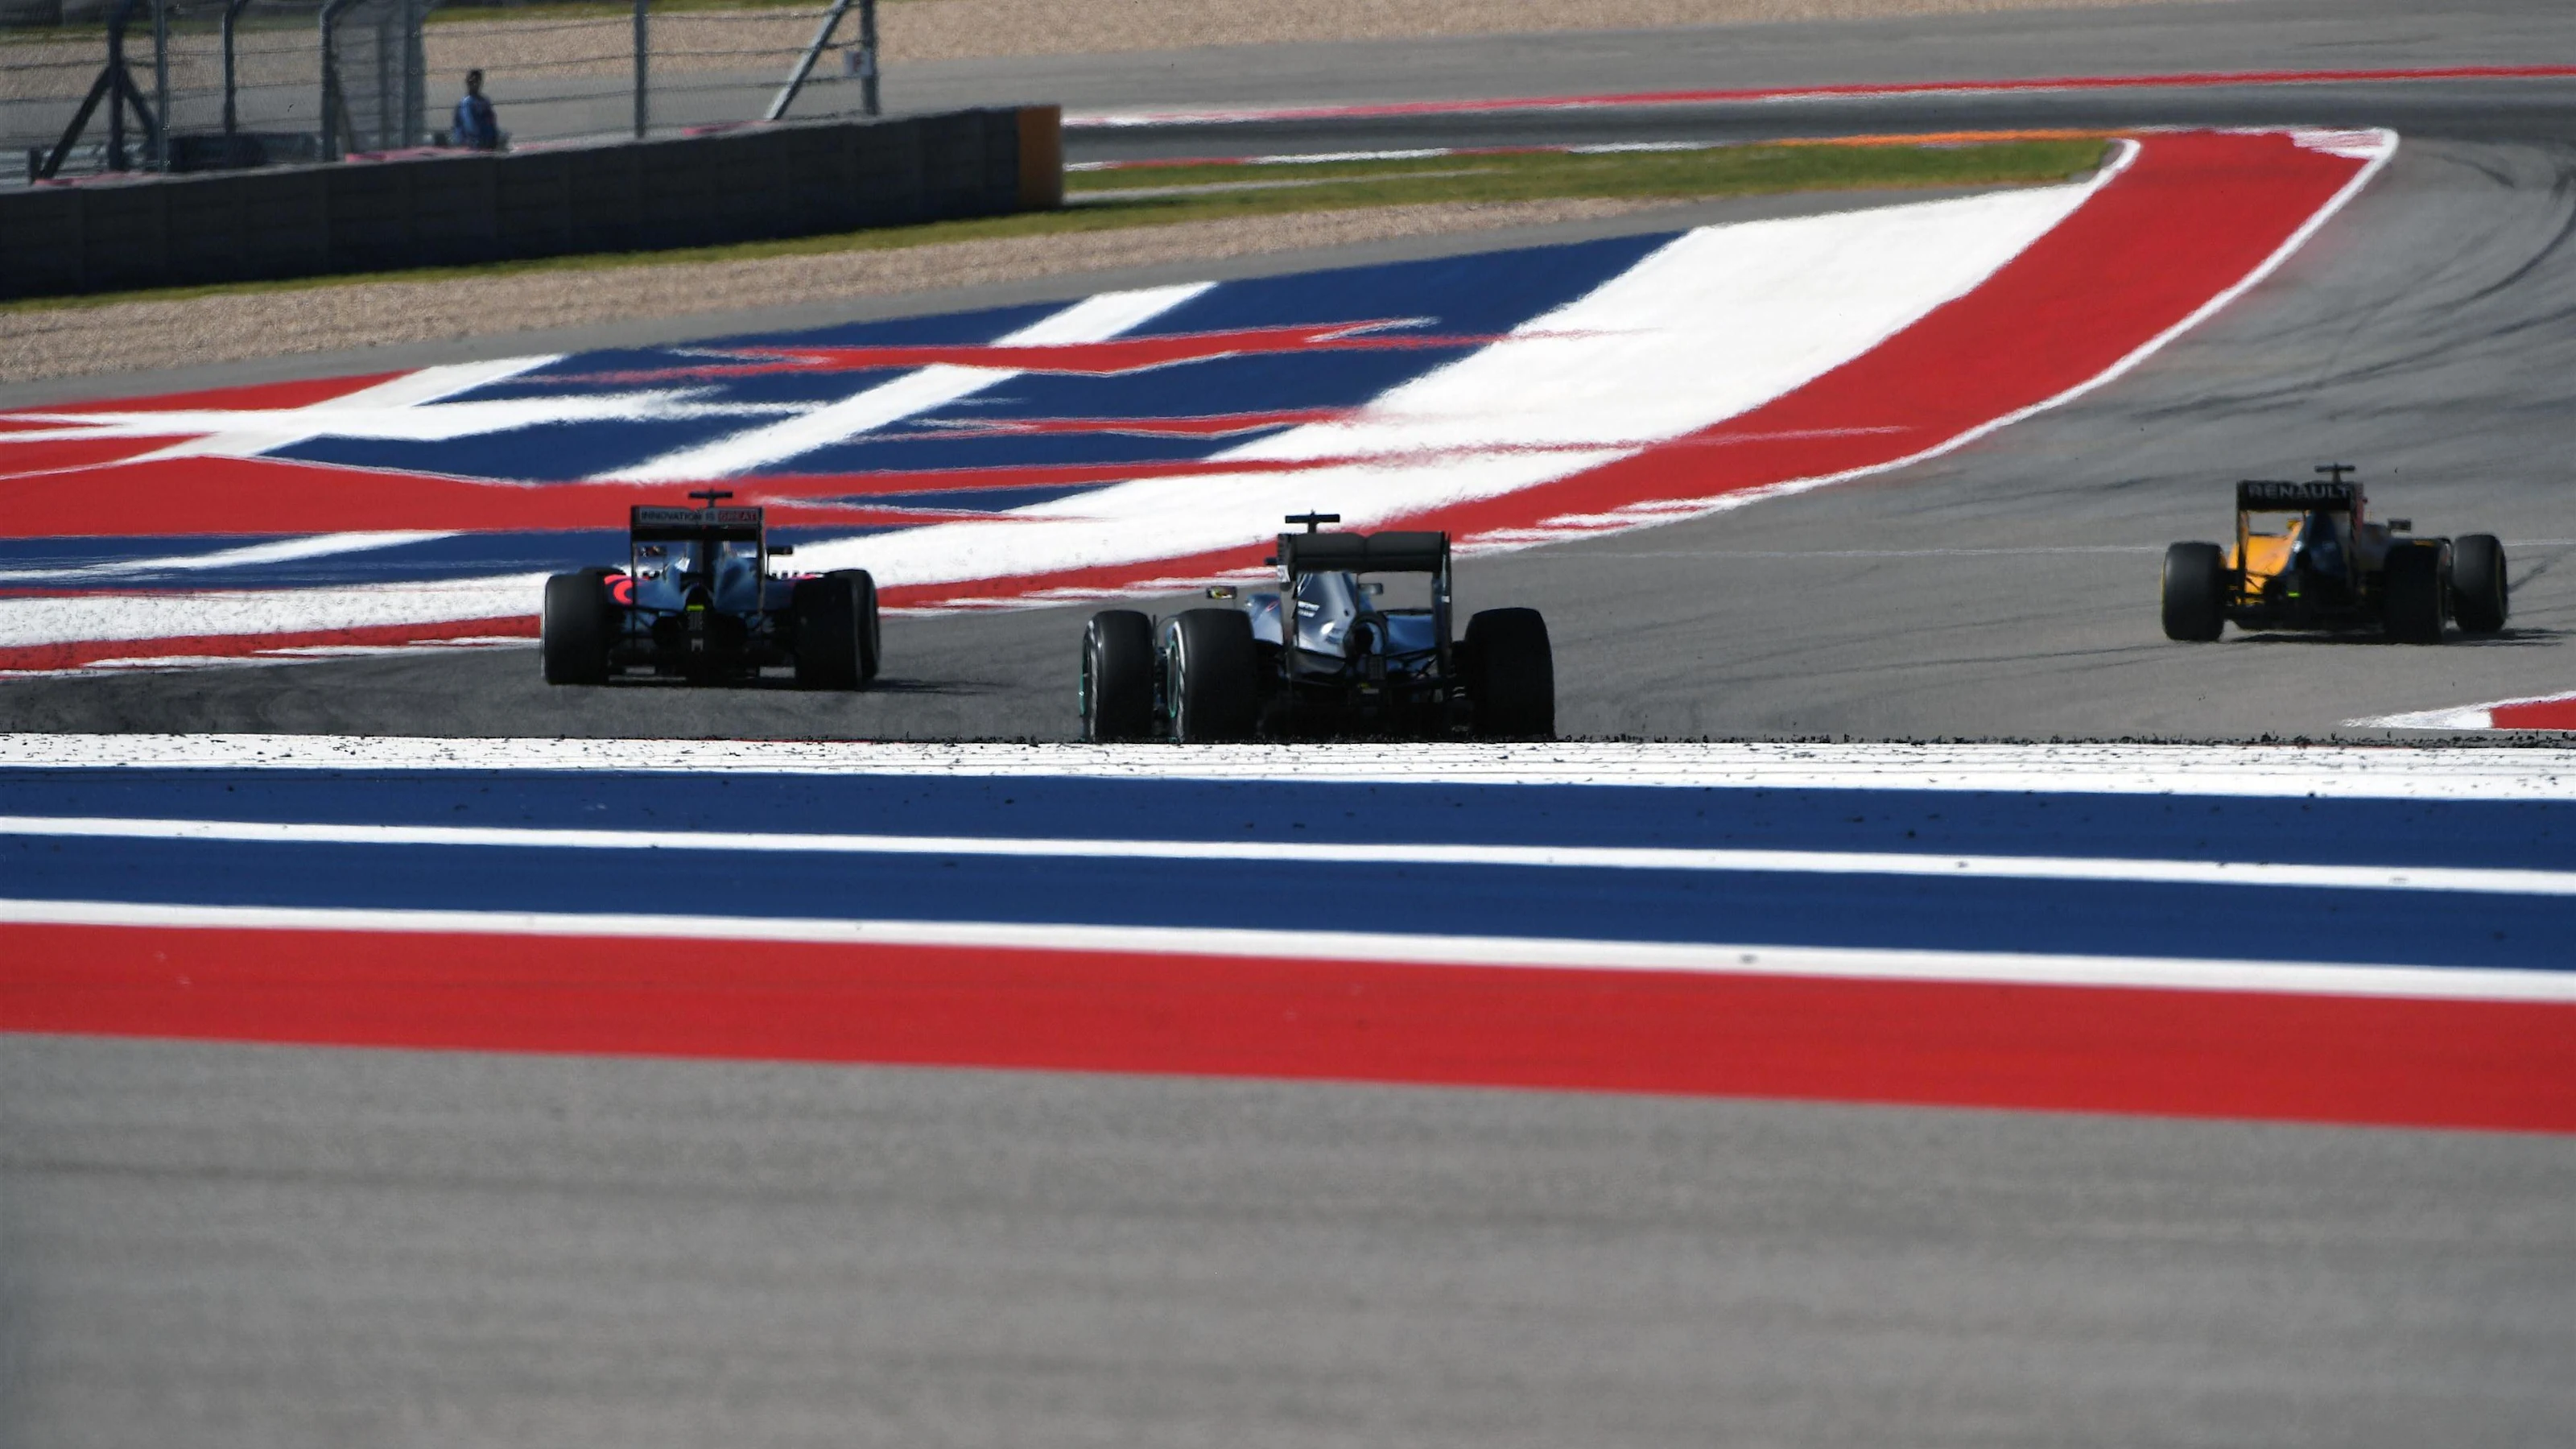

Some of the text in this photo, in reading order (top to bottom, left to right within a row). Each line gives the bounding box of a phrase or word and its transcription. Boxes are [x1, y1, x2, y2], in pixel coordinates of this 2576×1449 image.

[2248, 484, 2350, 499] RENAULT
[641, 511, 702, 522] INNOVATION
[705, 511, 715, 521] IS
